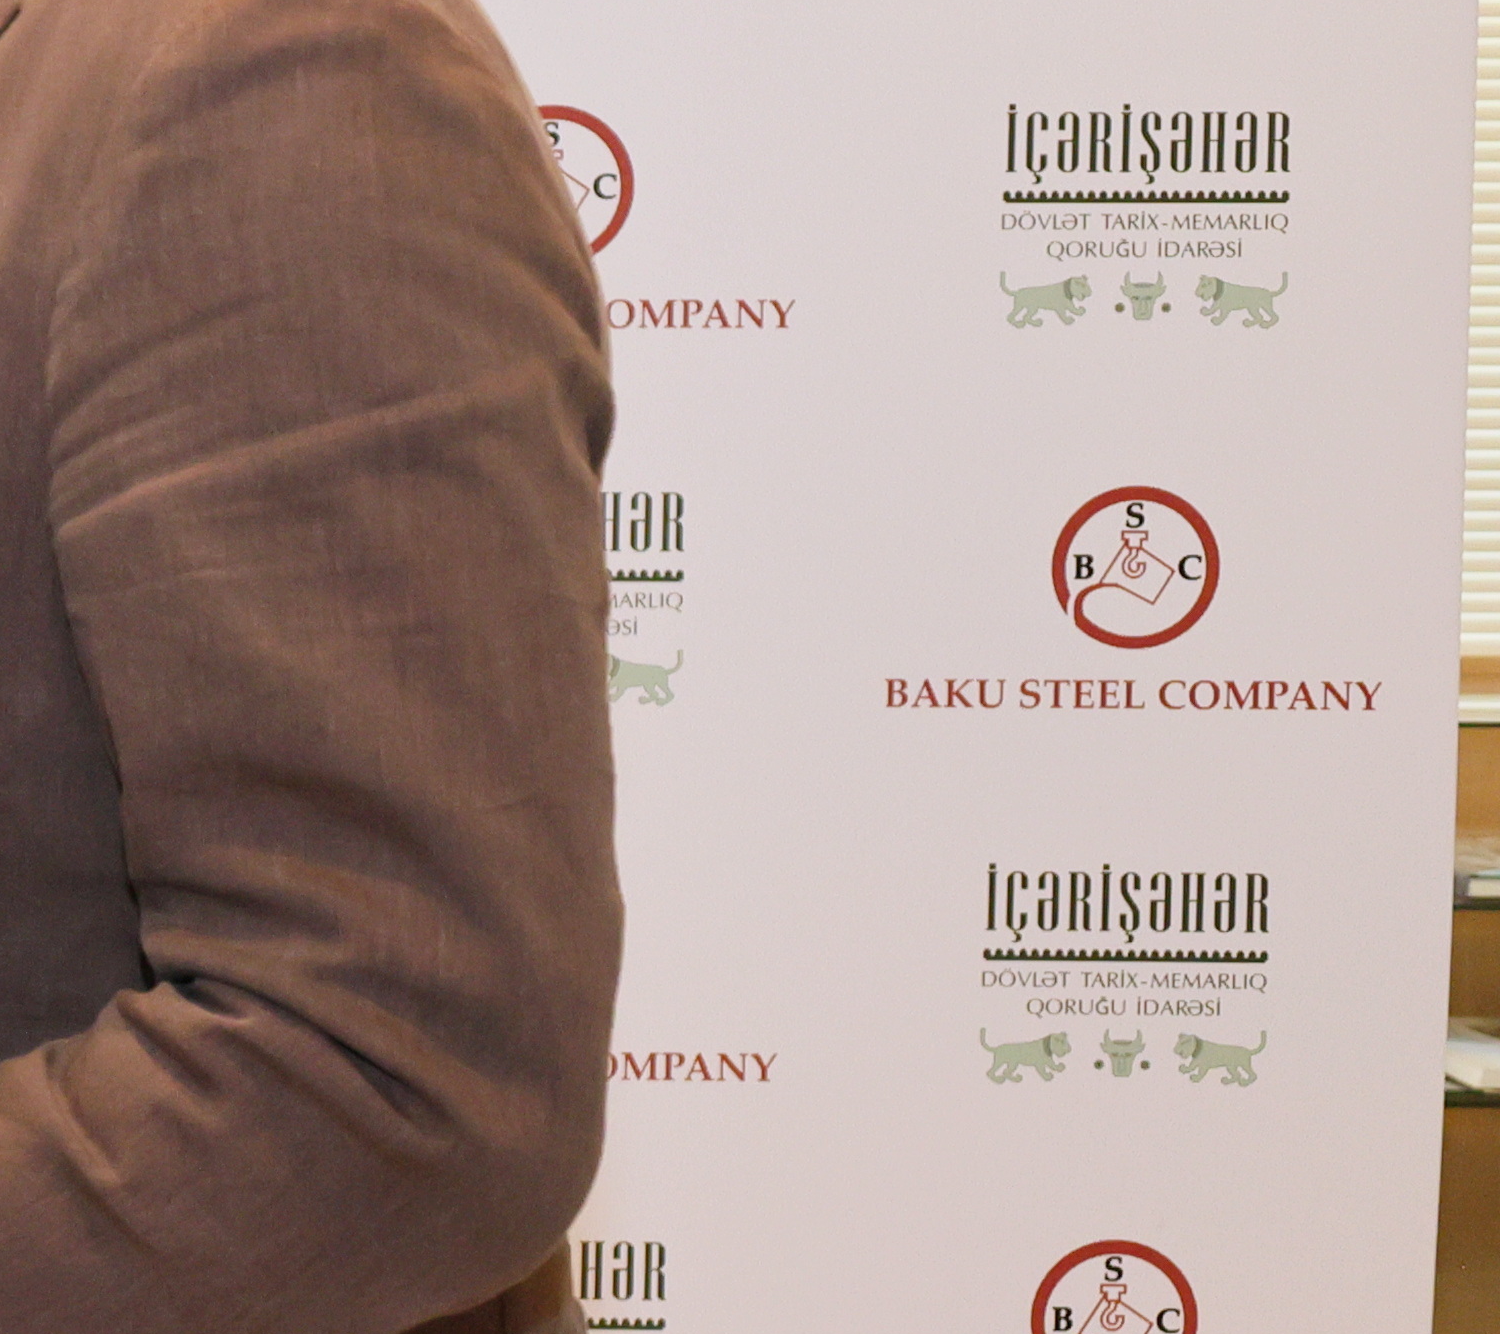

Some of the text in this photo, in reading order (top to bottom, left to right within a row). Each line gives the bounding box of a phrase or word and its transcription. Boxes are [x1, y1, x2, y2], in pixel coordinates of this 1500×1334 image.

[1000, 210, 1092, 231] DÖVLƏT
[1046, 237, 1147, 262] QORUĞU
[1126, 503, 1144, 528] S
[1075, 555, 1202, 580] B C
[885, 678, 1382, 711] BAKU STEEL COMPANY
[981, 968, 1071, 989] DÖVLƏT
[1025, 996, 1127, 1020] QORUĞU
[1105, 1257, 1123, 1281] S
[1054, 1307, 1180, 1333] B C
